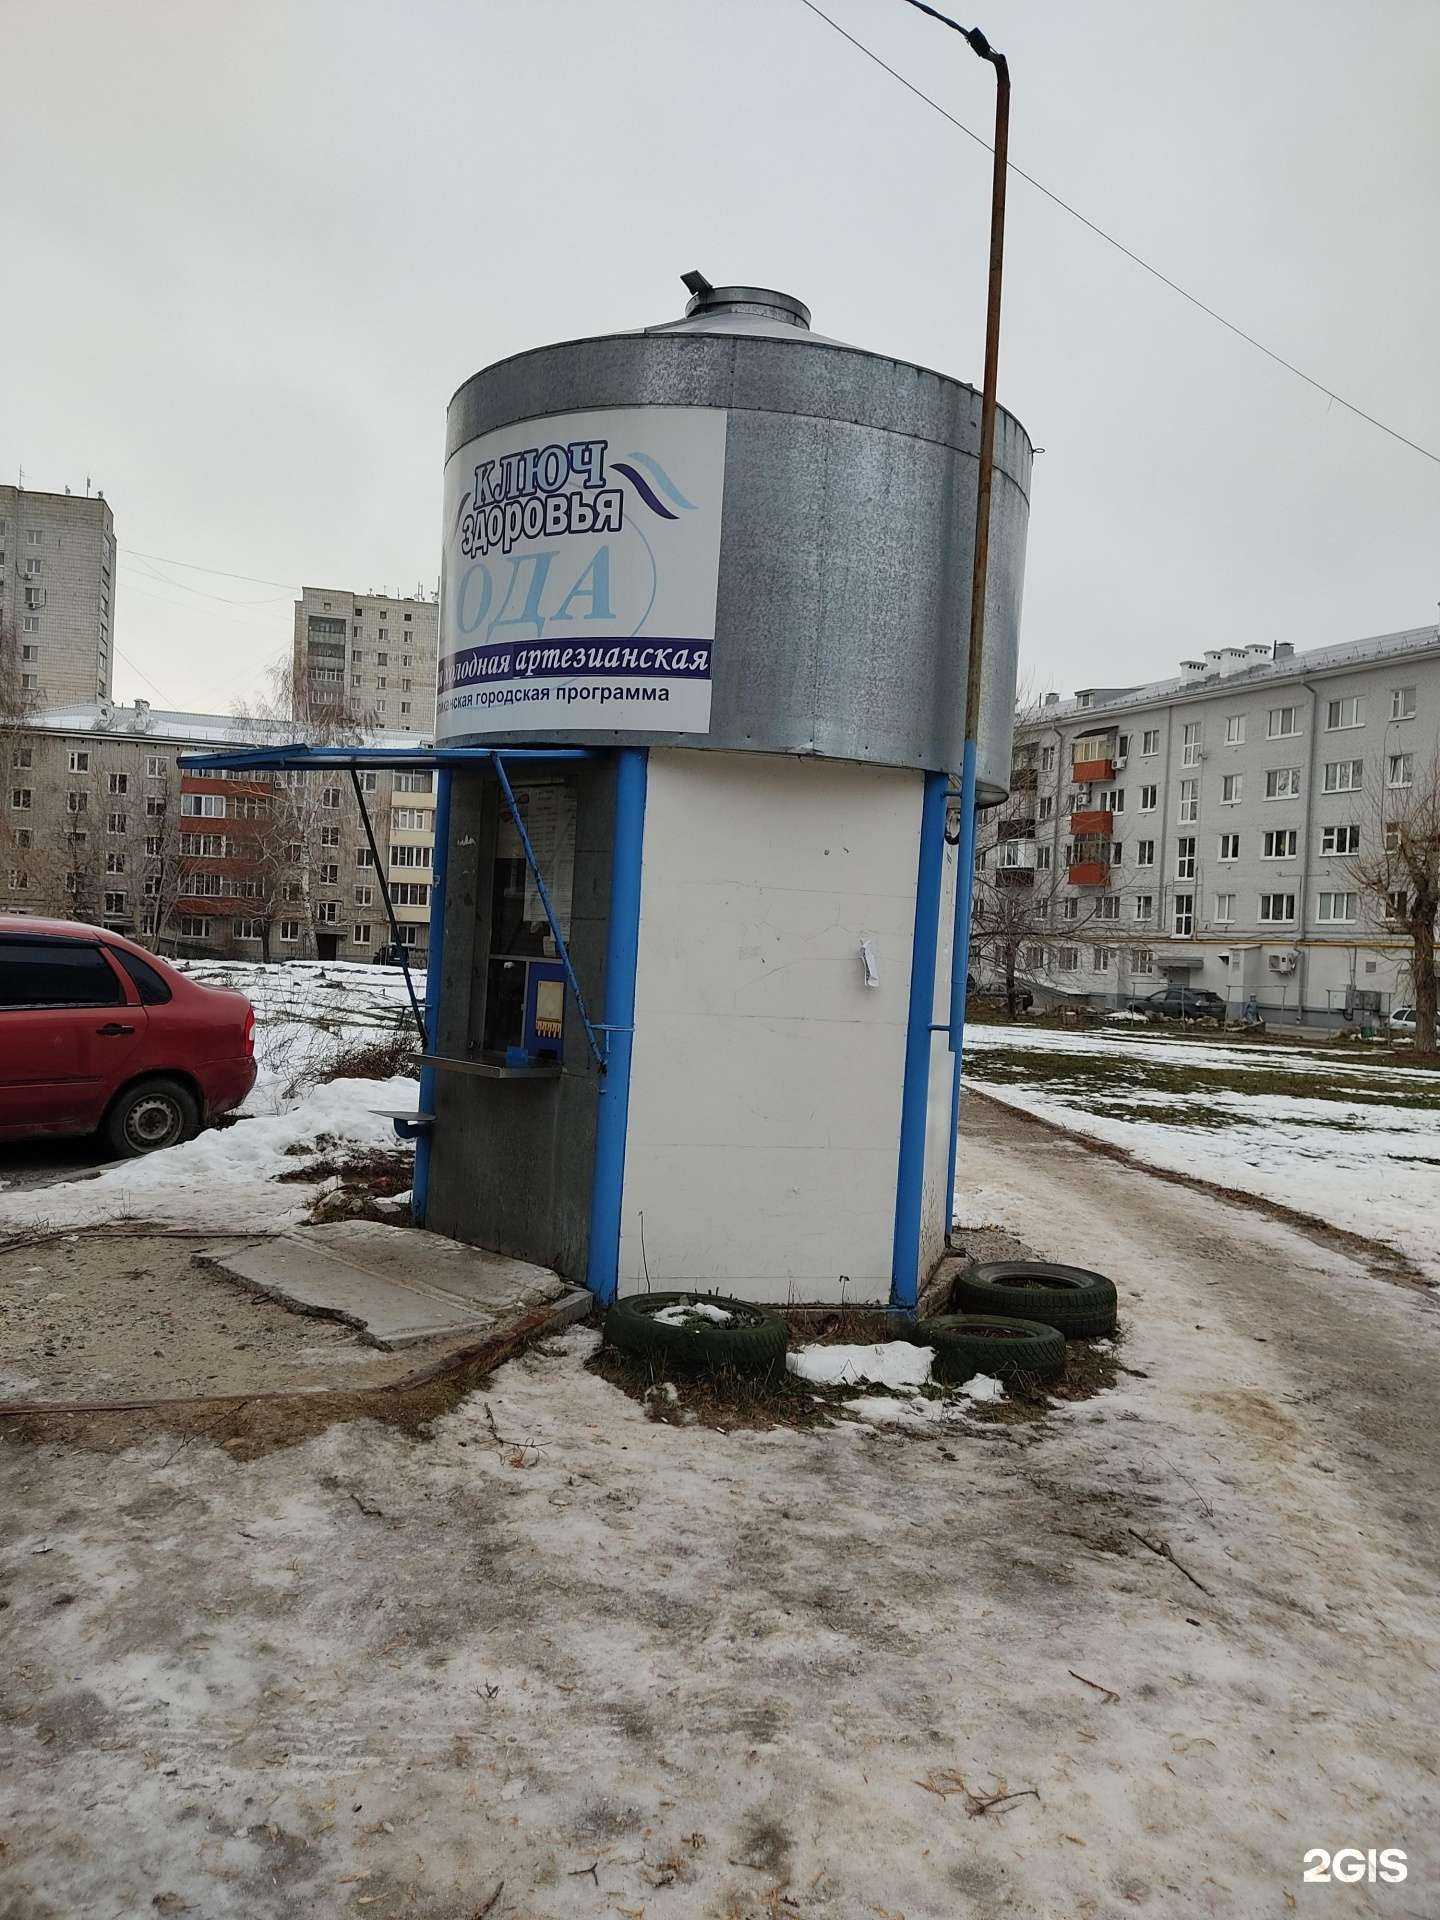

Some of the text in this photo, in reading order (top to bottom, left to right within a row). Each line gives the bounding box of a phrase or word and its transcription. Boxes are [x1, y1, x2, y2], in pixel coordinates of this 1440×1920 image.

[473, 440, 608, 510] КЛЮЧ
[457, 544, 617, 645] ОДА
[515, 646, 709, 676] артезианская
[476, 687, 550, 708] городская
[556, 686, 669, 704] программа
